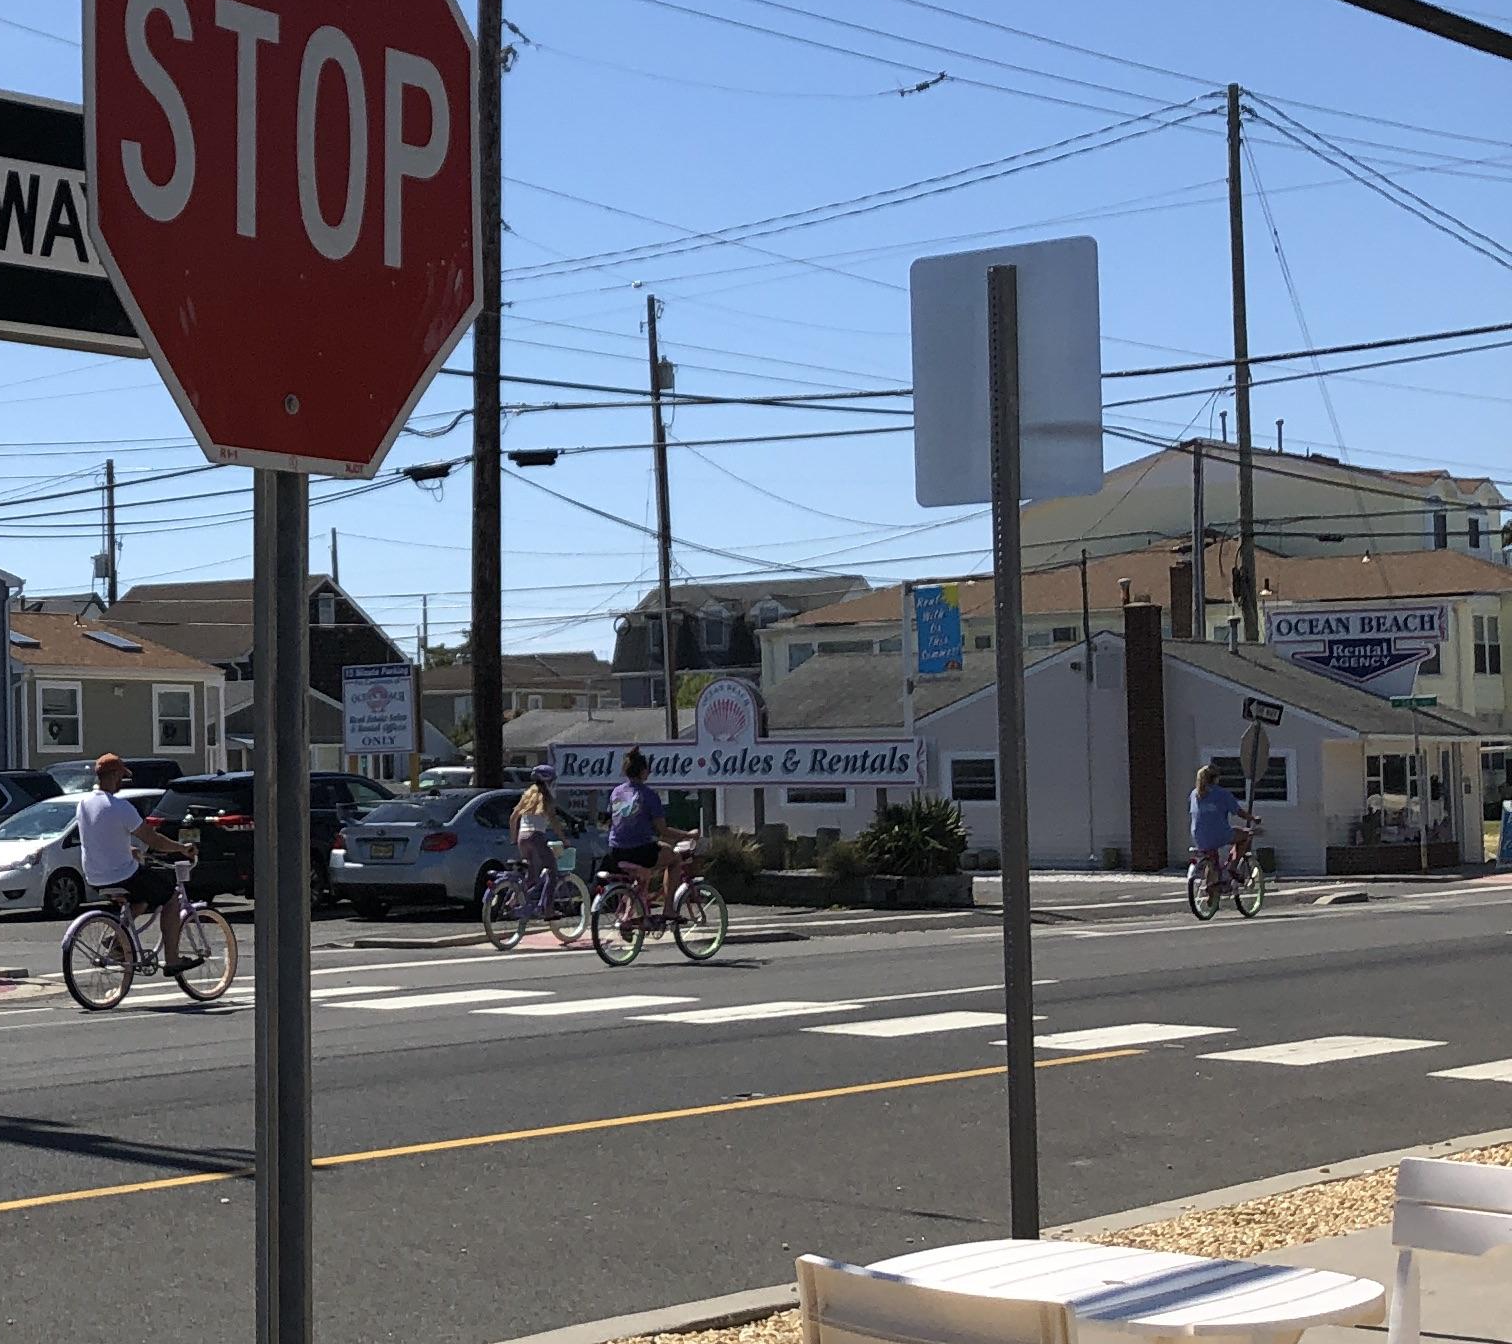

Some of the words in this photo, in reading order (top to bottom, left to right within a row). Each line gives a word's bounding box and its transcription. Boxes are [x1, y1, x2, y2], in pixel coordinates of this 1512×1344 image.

[1276, 616, 1351, 636] OCEAN
[1359, 613, 1436, 634] BEACH
[1332, 643, 1388, 657] Rental
[1329, 656, 1391, 668] AGENCY
[361, 736, 396, 746] ONLY
[561, 750, 615, 777] Real
[707, 747, 774, 776] Sales
[782, 748, 801, 775] &
[808, 746, 911, 775] Rentals
